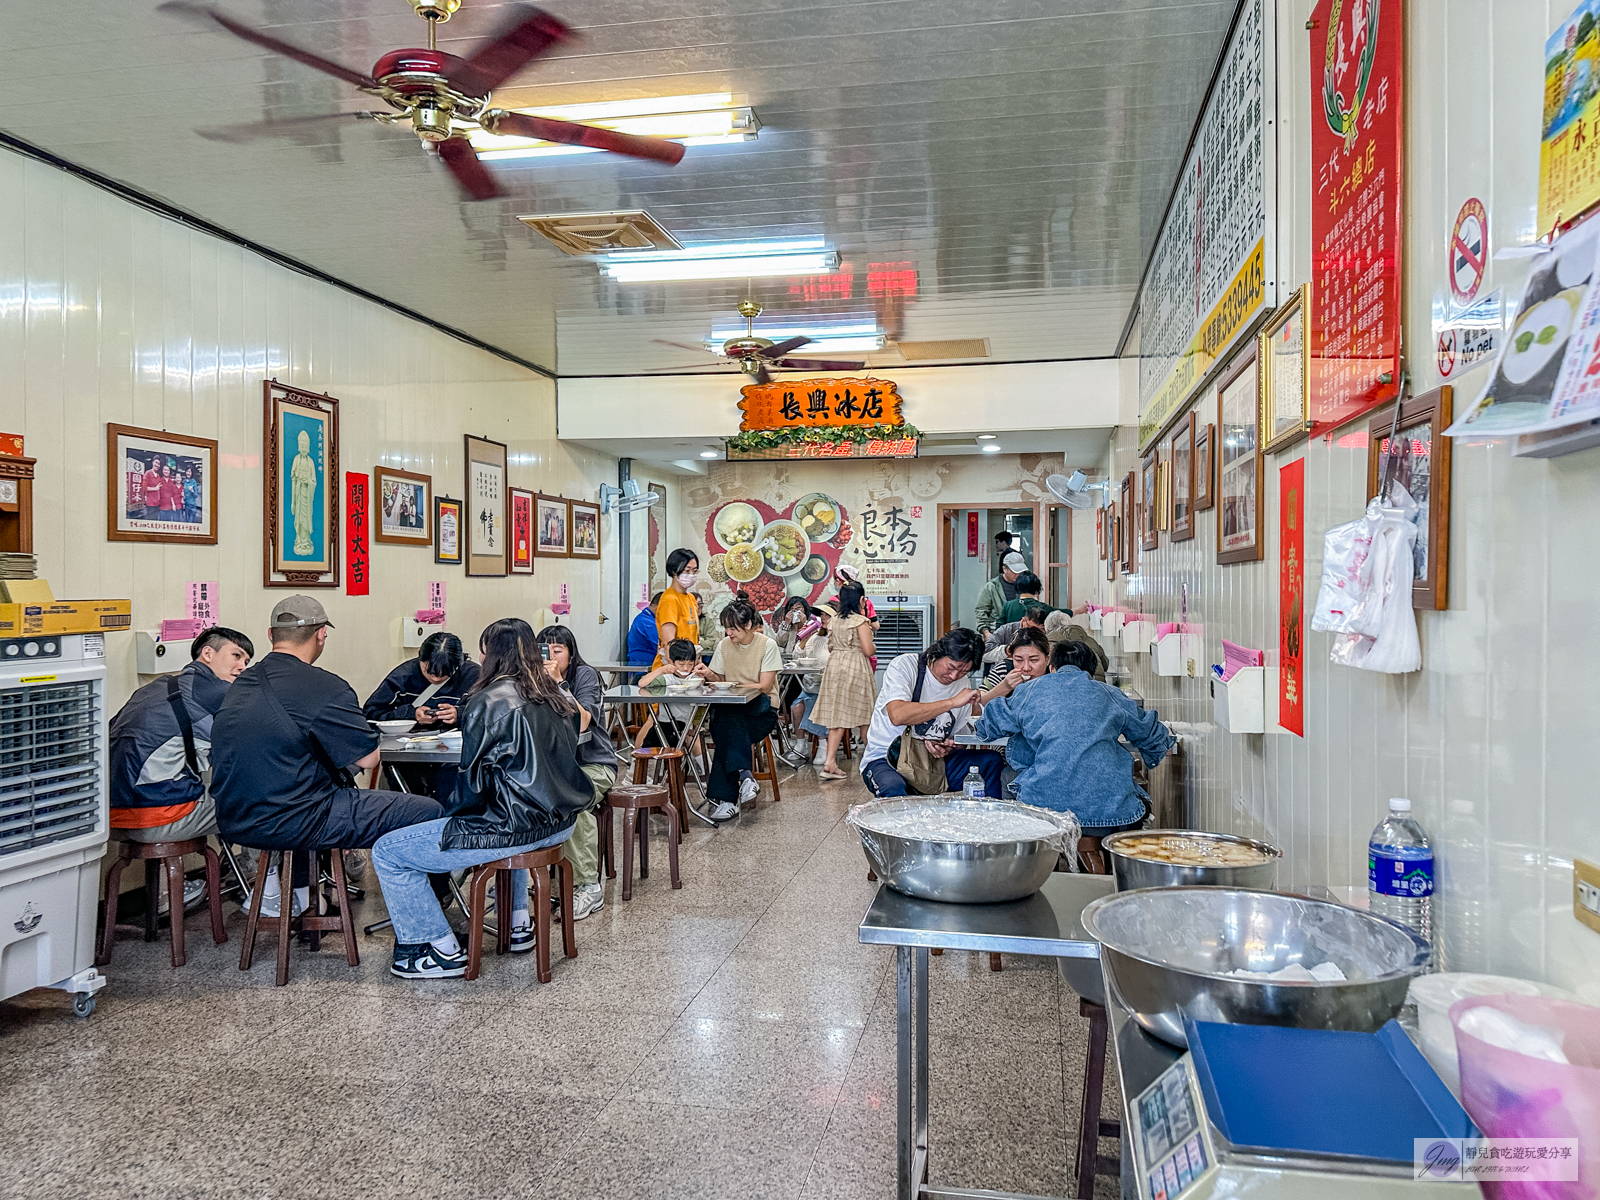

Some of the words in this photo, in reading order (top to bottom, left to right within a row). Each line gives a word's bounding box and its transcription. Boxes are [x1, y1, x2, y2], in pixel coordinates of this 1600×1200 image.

[1363, 76, 1389, 131] 老店
[1318, 146, 1339, 193] 三代
[1328, 138, 1375, 216] 斗六總店
[1461, 345, 1475, 366] No
[1476, 335, 1494, 361] pet
[779, 388, 884, 421] 長興冰店
[132, 473, 142, 502] 圓仔冰
[351, 484, 366, 584] 開市大吉
